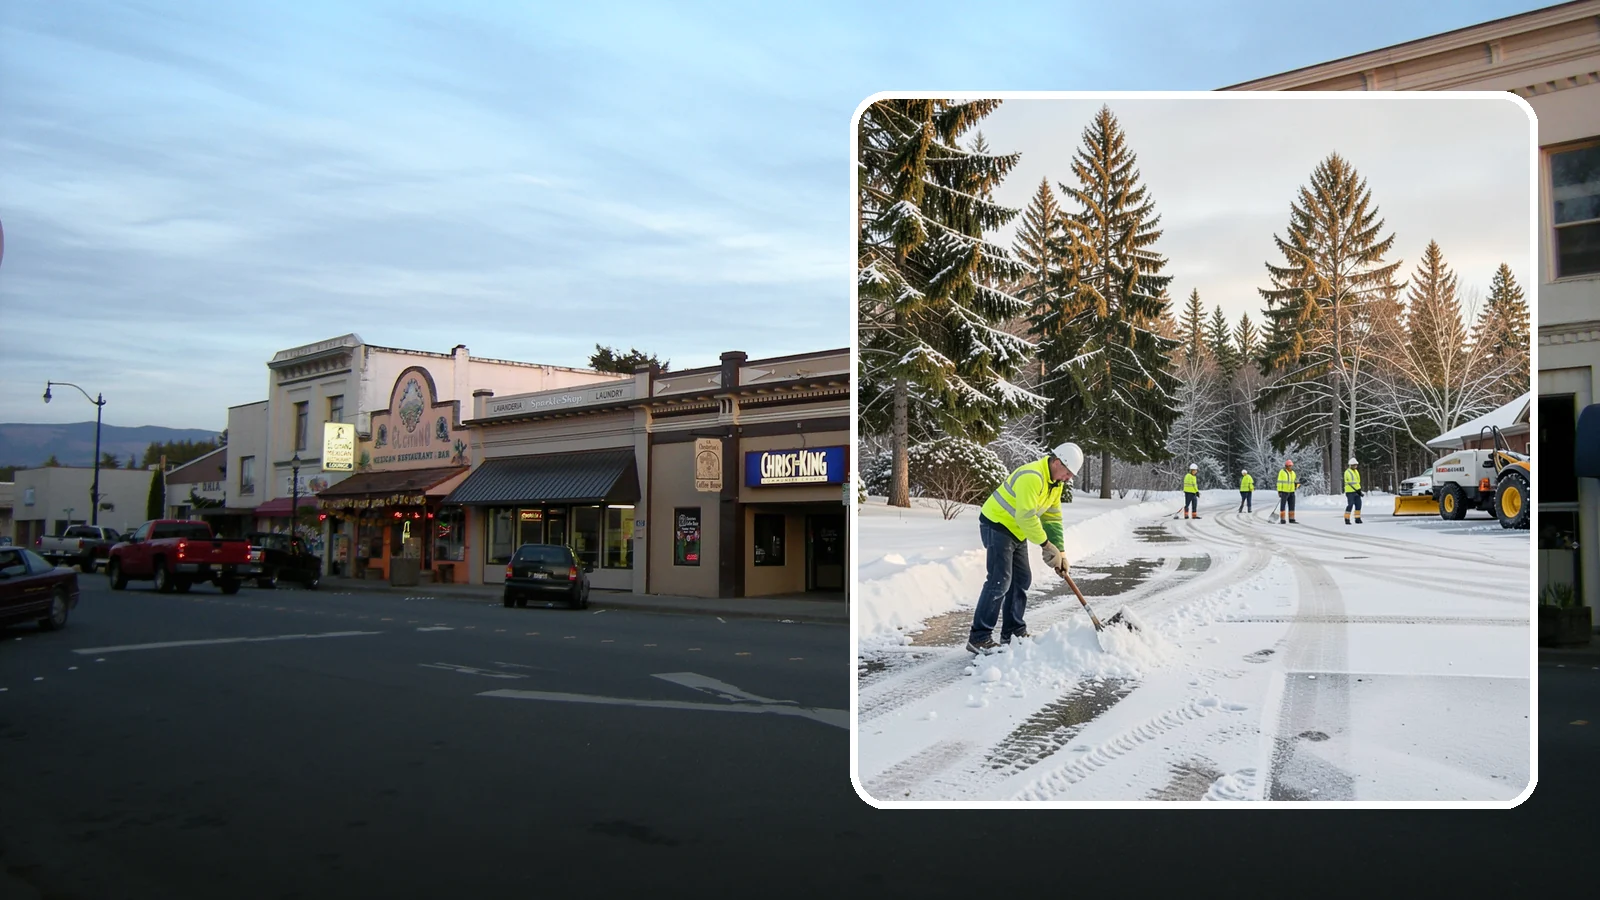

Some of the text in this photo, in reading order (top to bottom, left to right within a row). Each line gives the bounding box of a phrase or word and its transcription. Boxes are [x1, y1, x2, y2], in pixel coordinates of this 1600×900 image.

[493, 389, 624, 413] LAVANDERIA Sparkle Shop LAUNDRY
[373, 455, 396, 464] MEXICAN
[397, 451, 434, 462] RESTAURANT
[438, 450, 450, 459] BAR
[760, 450, 827, 477] CHRIST KING
[710, 481, 722, 489] House
